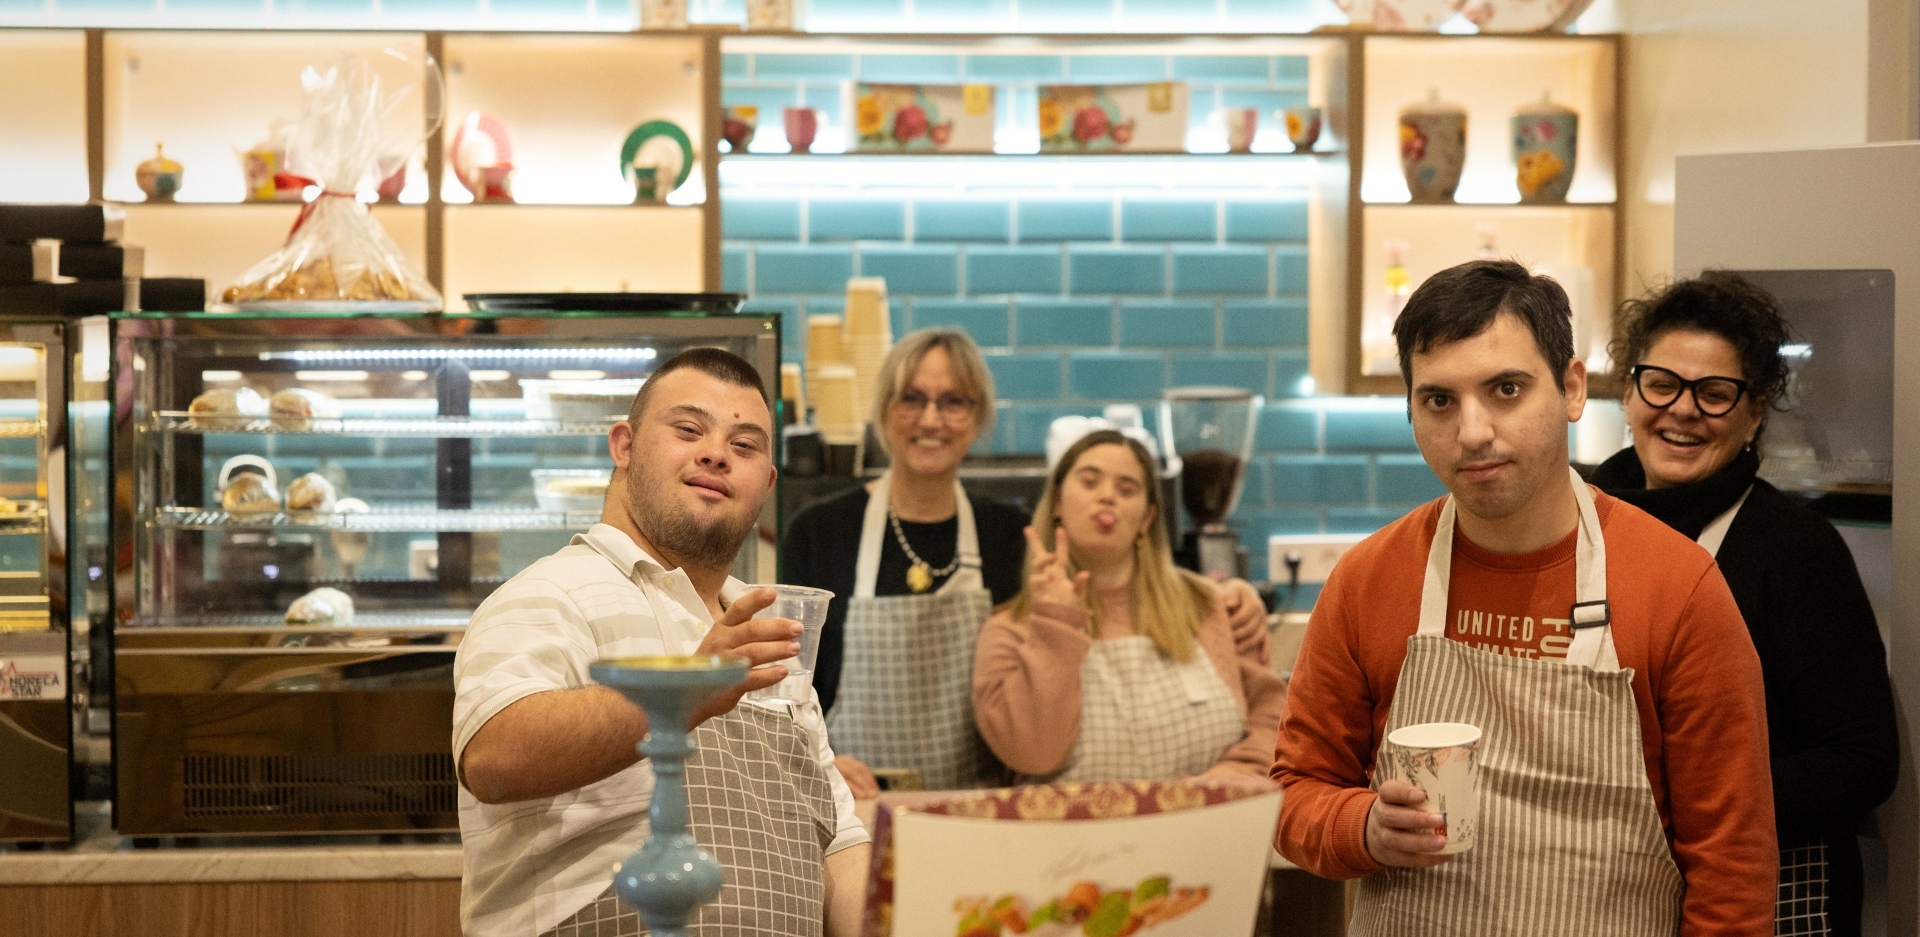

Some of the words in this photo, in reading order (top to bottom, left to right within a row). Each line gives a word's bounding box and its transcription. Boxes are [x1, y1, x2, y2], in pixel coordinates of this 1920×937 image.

[1457, 610, 1535, 642] UNITED
[1539, 617, 1576, 665] FO
[9, 675, 60, 687] HORECA
[11, 686, 42, 699] STAR
